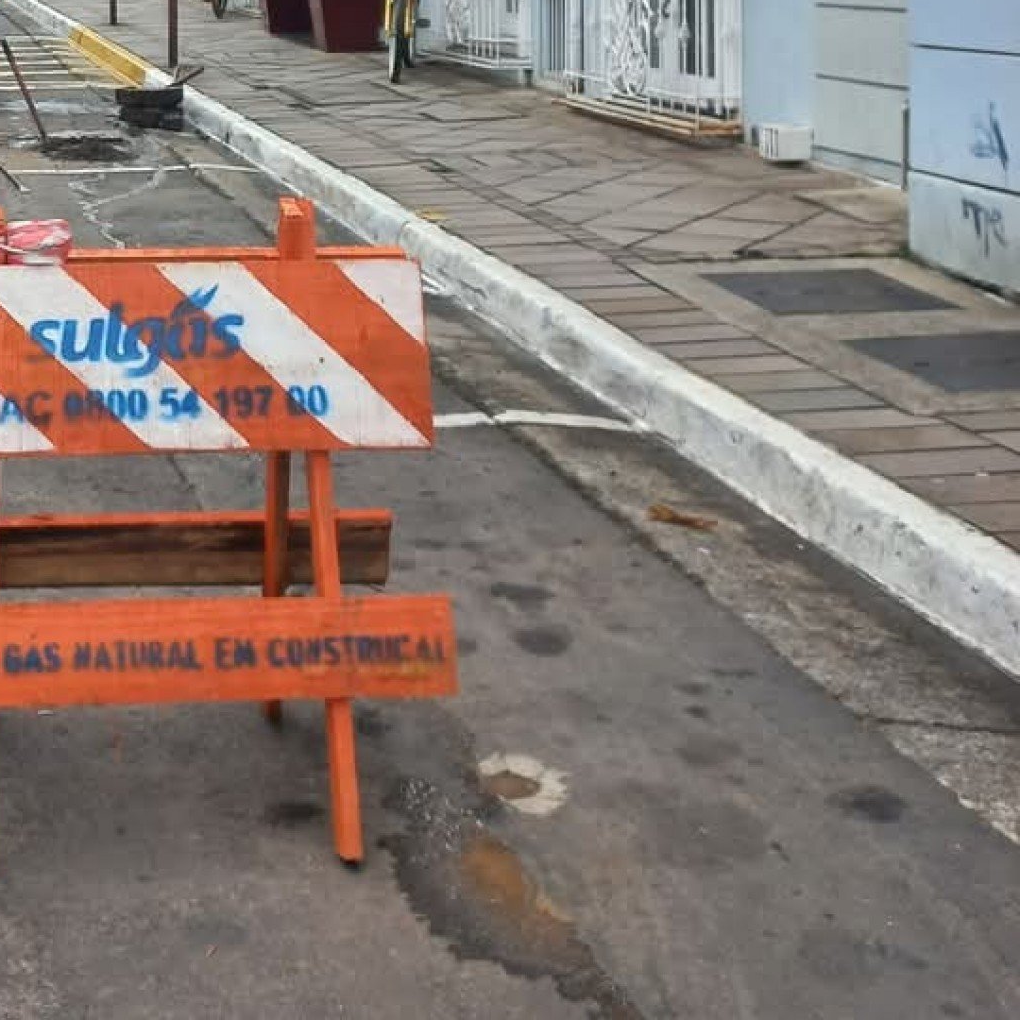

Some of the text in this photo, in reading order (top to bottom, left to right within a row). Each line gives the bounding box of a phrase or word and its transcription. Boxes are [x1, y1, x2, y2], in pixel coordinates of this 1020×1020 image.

[159, 385, 203, 421] 54
[213, 383, 273, 420] 197
[287, 381, 329, 418] 00
[73, 636, 203, 672] NATURAL
[214, 636, 258, 670] EM
